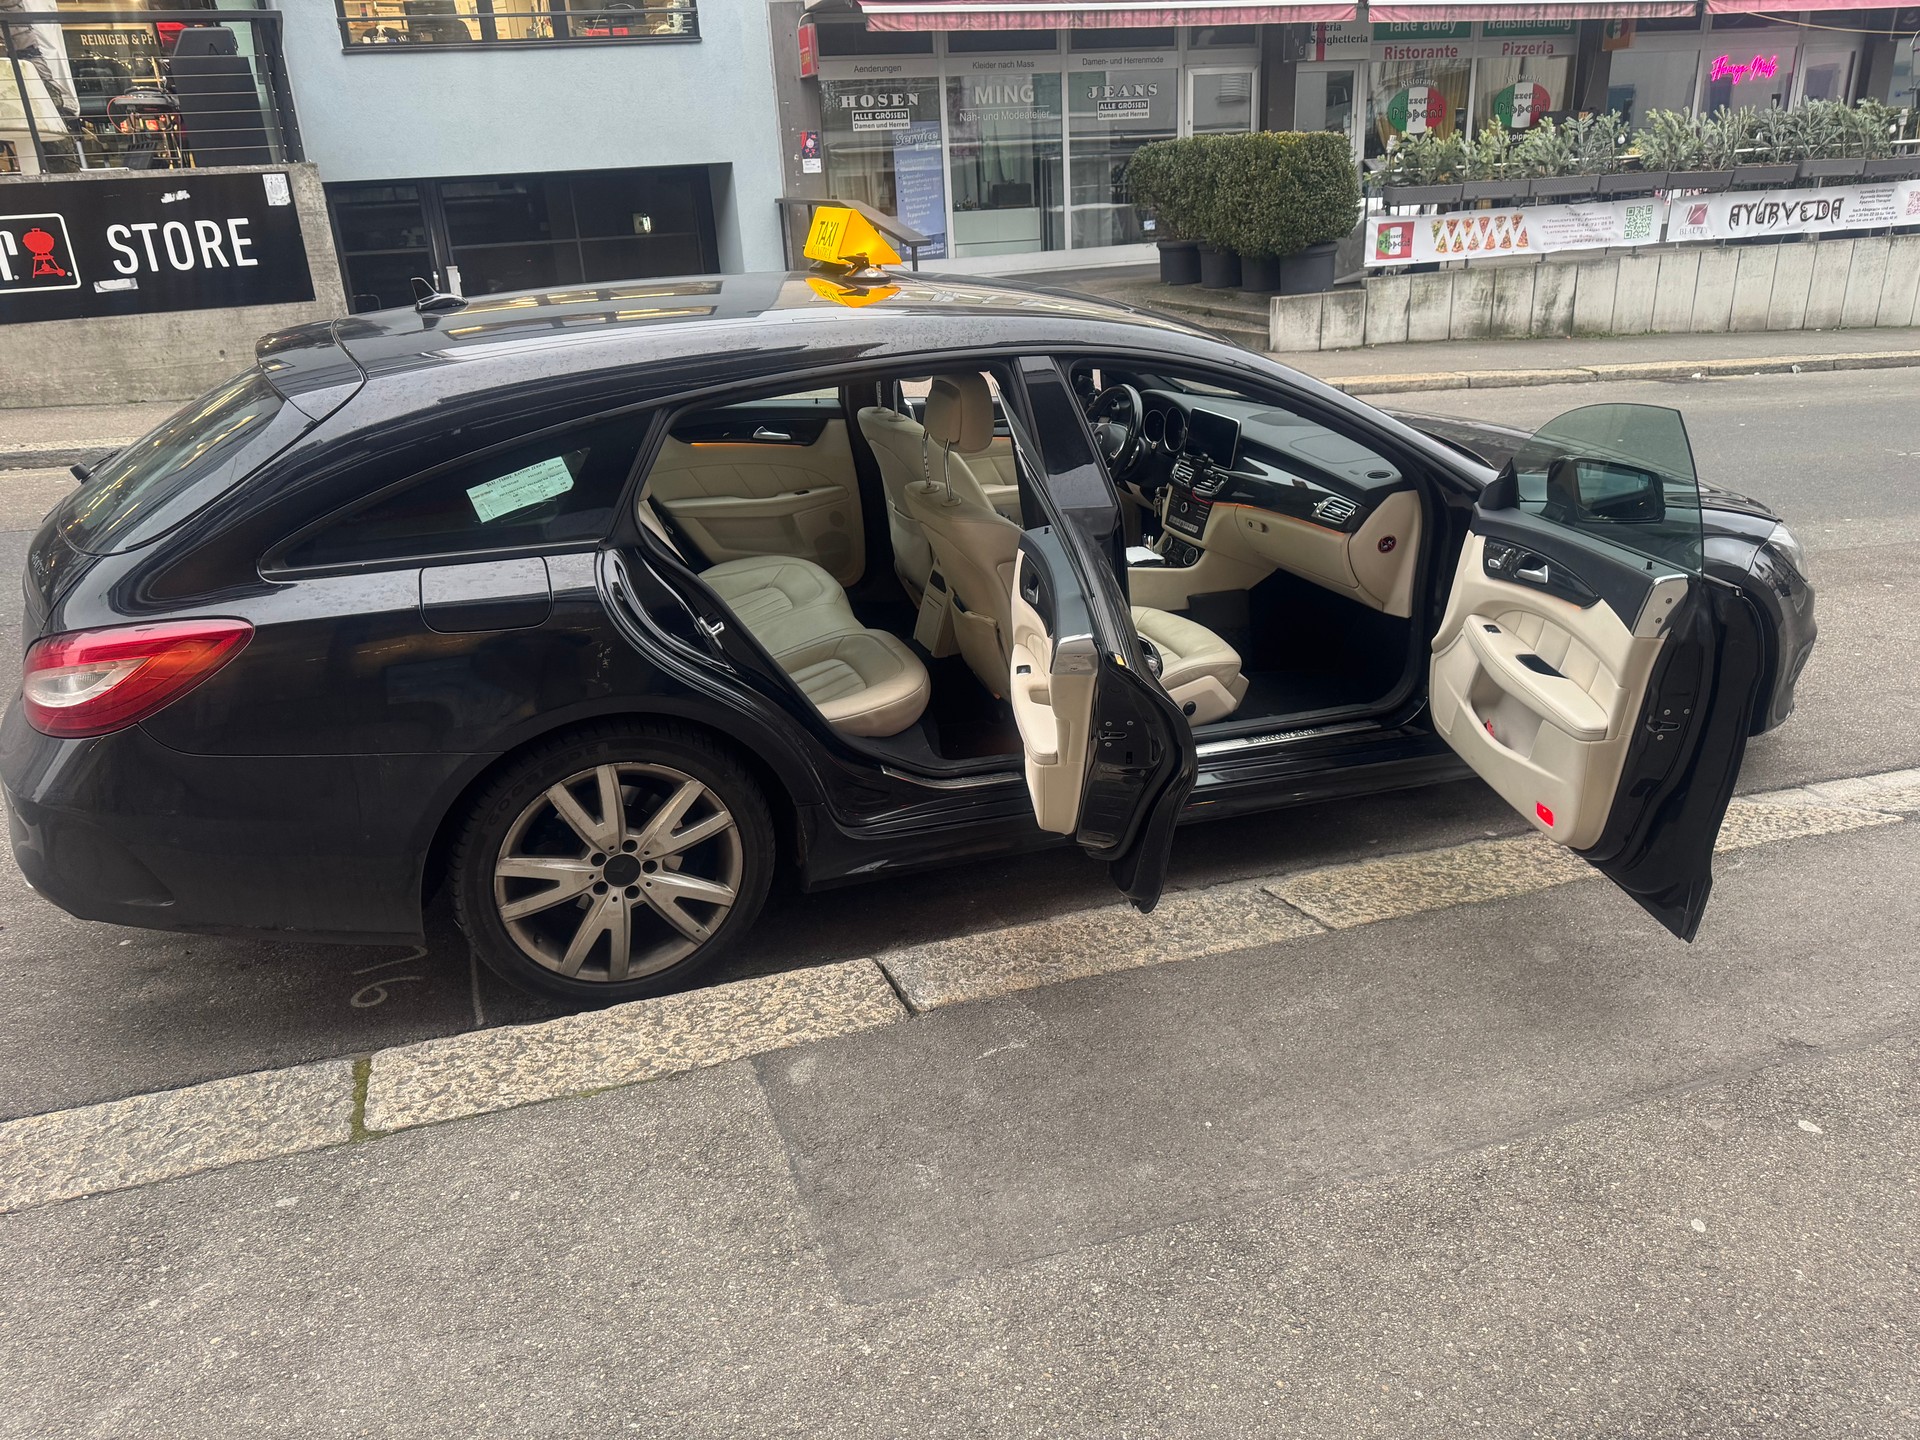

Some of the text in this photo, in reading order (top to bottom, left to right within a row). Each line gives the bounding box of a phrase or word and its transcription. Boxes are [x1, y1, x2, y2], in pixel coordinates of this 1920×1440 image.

[1423, 21, 1457, 34] away
[80, 34, 129, 46] REINIGEN
[131, 34, 140, 45] &
[1311, 34, 1369, 46] Spaghetteria
[1384, 44, 1458, 60] Ristorante
[1502, 40, 1554, 56] Pizzeria
[972, 60, 1035, 69] Kleider nach Mass
[1082, 56, 1164, 66] Damen- und Herrenmode
[854, 65, 902, 74] Aenderungen
[1401, 78, 1438, 88] Ristorante
[974, 84, 1035, 105] MING
[1087, 82, 1158, 99] JEANS
[840, 93, 920, 108] HOSEN
[1099, 101, 1147, 110] ALLE GRÖSSEN
[1098, 110, 1148, 119] Damen und Herren
[1391, 104, 1443, 122] Pipponi
[1498, 99, 1547, 117] Pipponi
[854, 110, 908, 121] ALLE GRÖSSEN
[960, 109, 1050, 122] Näh- und Modeatelier
[854, 121, 876, 129] Damen
[889, 119, 909, 128] Herren
[896, 132, 938, 146] Service
[1729, 197, 1845, 231] AYURVEDA
[816, 220, 840, 247] TAXI
[106, 217, 259, 275] STORE
